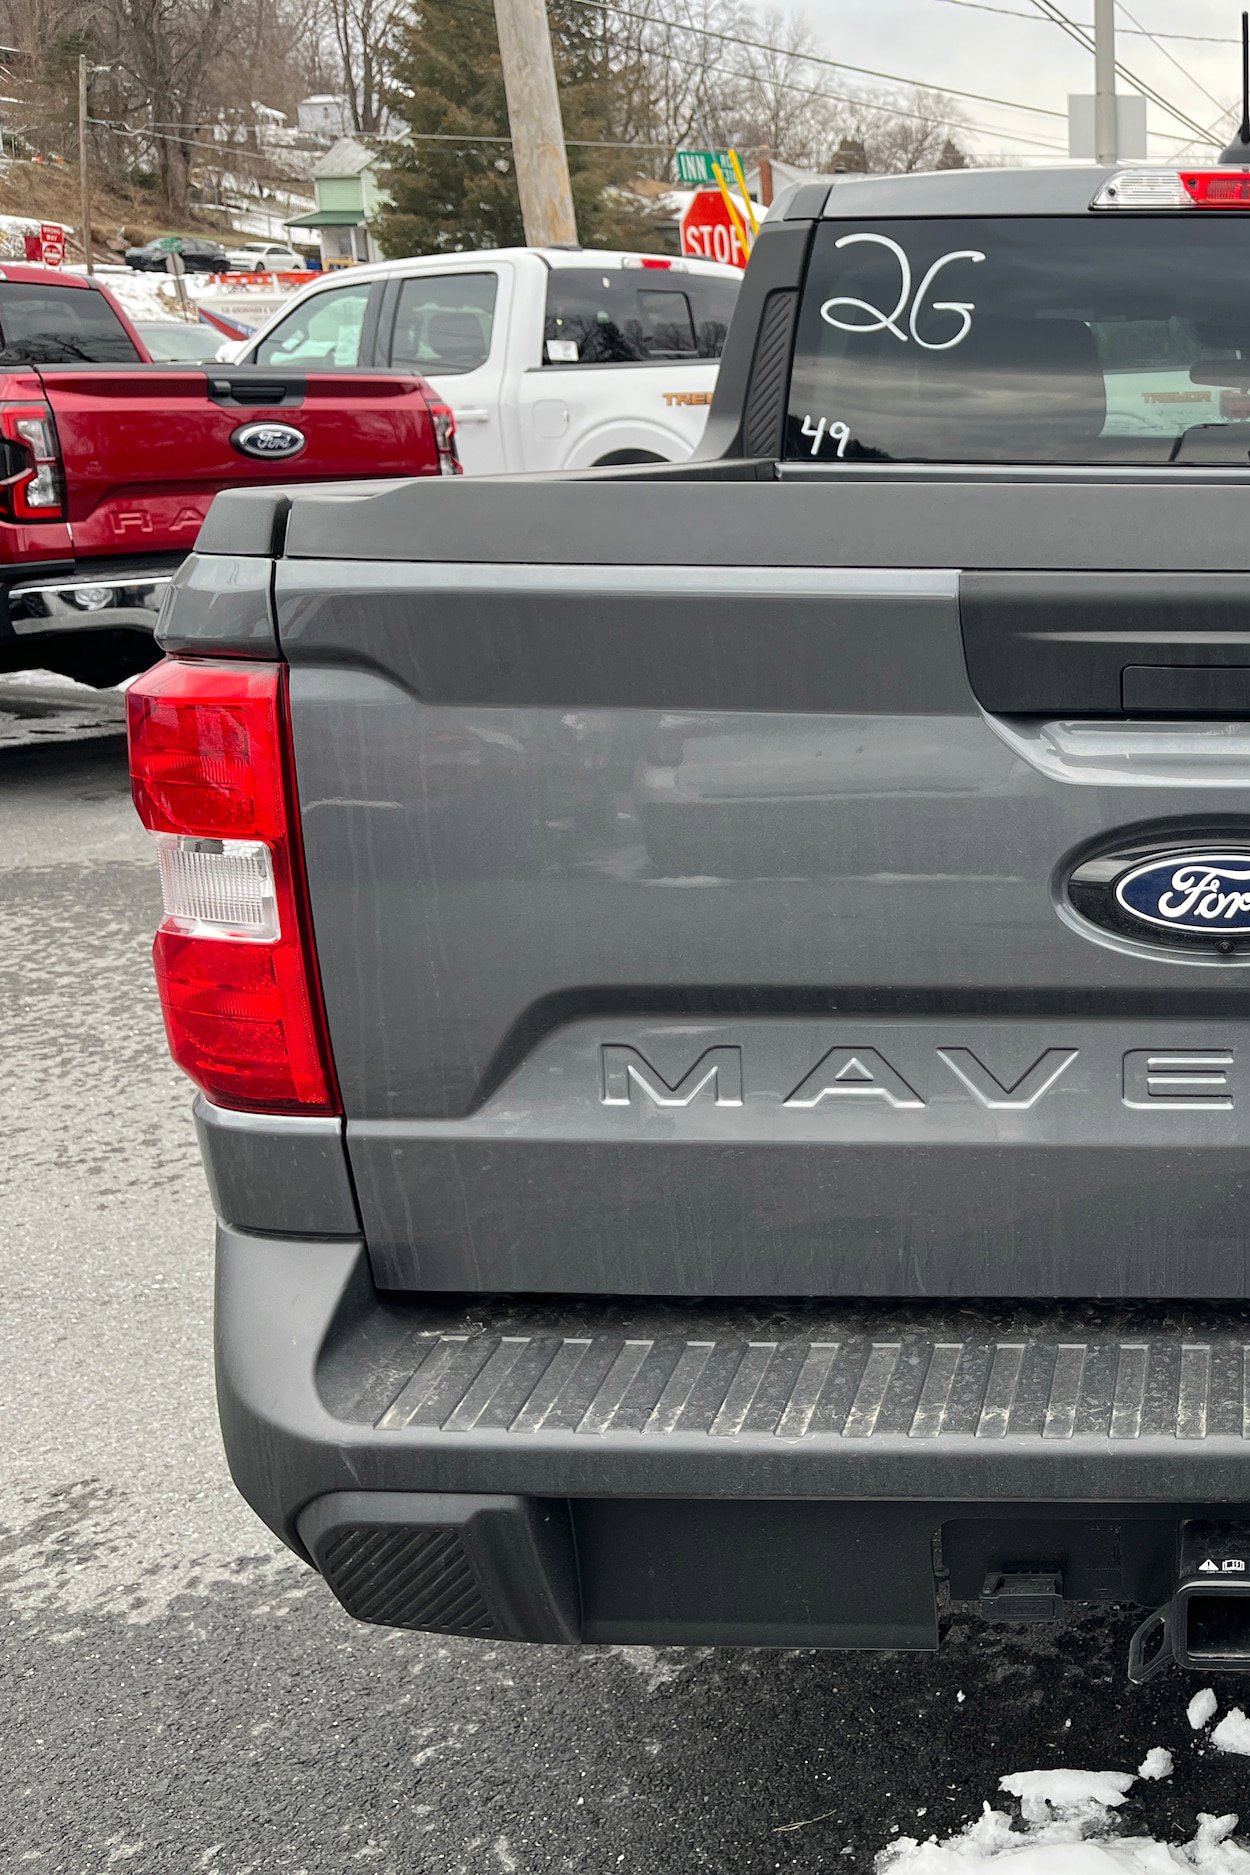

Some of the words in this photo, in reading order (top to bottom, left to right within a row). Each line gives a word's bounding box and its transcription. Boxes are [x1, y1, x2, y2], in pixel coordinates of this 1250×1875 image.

[680, 155, 708, 181] INN
[686, 223, 743, 265] STOP
[662, 392, 714, 406] TRE
[257, 431, 292, 449] Ford
[801, 414, 850, 458] 49
